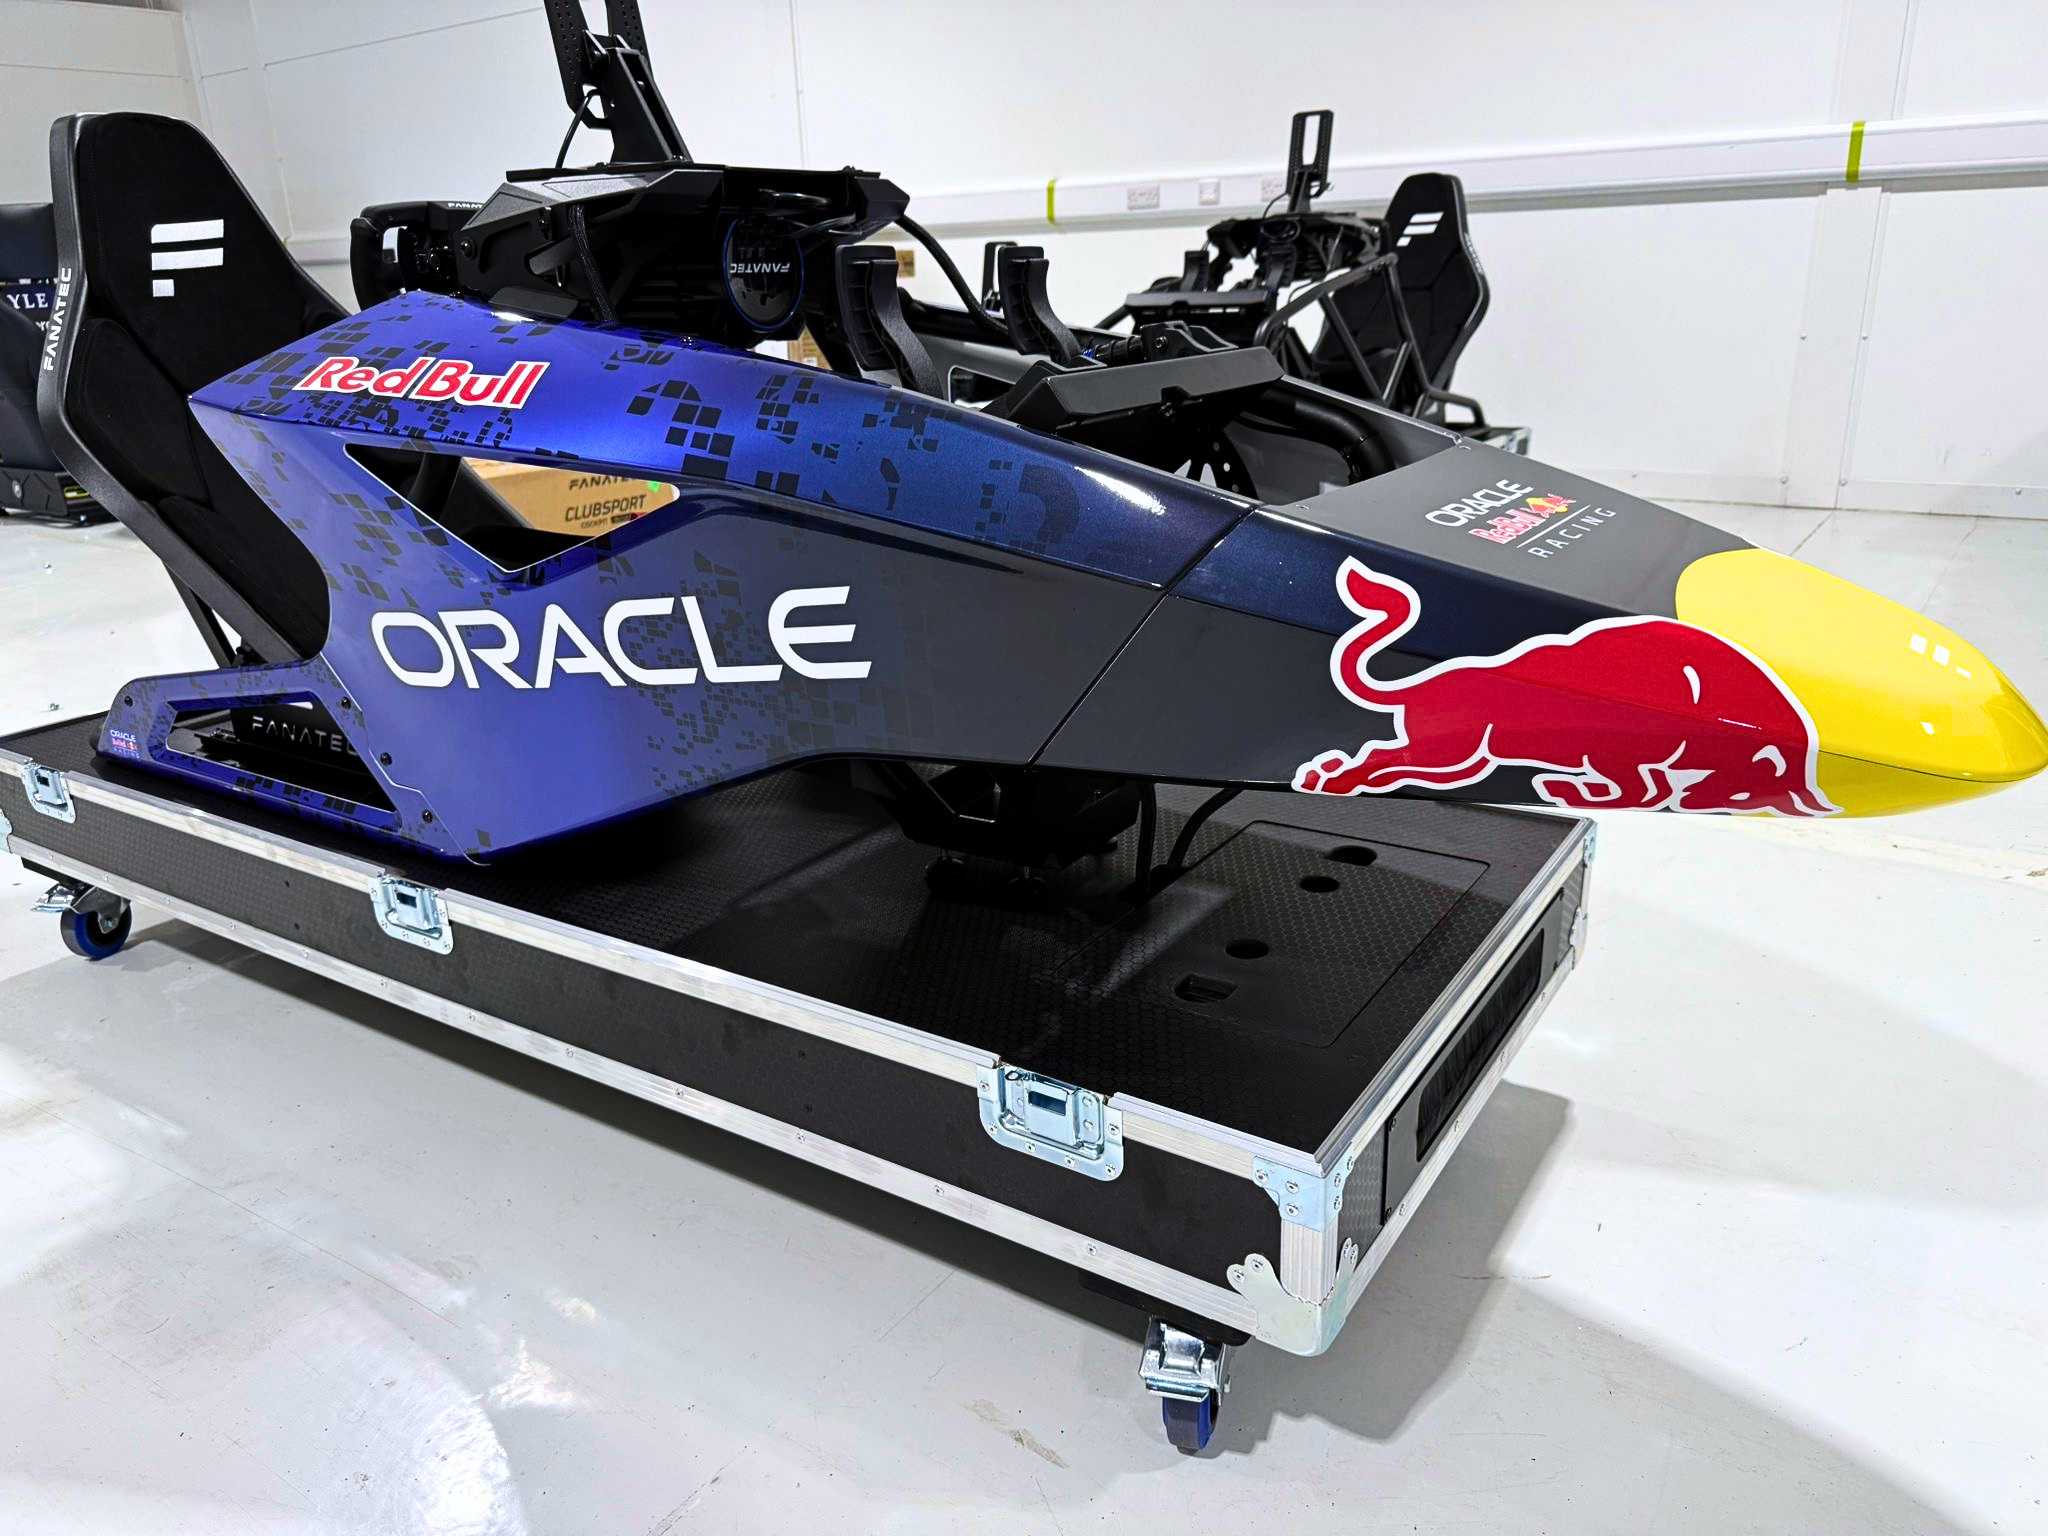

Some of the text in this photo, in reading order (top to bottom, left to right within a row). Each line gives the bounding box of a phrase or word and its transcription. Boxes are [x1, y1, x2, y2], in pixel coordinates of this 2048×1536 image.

[447, 202, 483, 210] FANAT
[729, 262, 791, 273] FANATEC
[43, 267, 72, 371] FANATEC
[564, 494, 647, 522] CLUBSPORT
[1425, 479, 1534, 527] ORACLE
[1527, 507, 1617, 559] RACING
[370, 585, 872, 689] ORACLE
